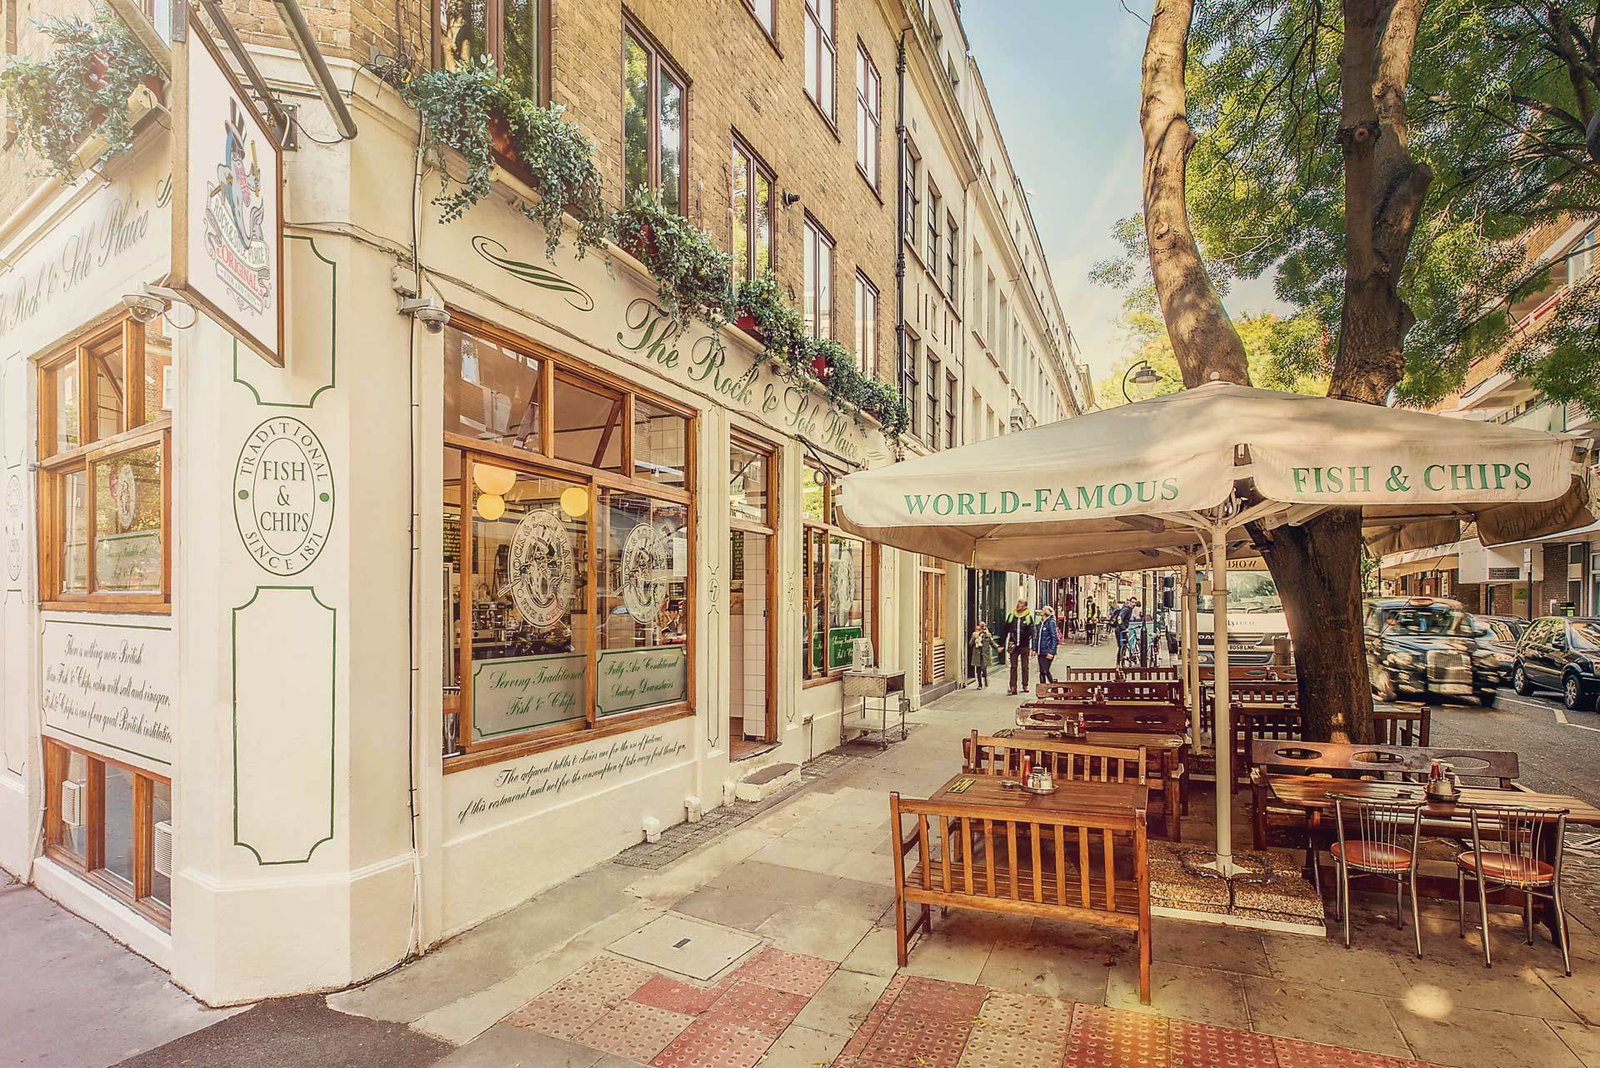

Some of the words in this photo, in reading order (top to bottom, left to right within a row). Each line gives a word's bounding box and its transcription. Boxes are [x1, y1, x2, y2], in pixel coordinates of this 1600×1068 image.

[9, 262, 45, 330] Rock
[62, 221, 95, 292] Sole
[98, 193, 149, 267] Plaice
[222, 245, 258, 292] ORIGINAL
[617, 298, 679, 369] The
[687, 335, 759, 404] Rock
[761, 383, 779, 414] &
[784, 386, 819, 438] Sole
[821, 410, 858, 458] Plaice
[240, 422, 328, 482] TRADITIONAL
[262, 460, 305, 481] FISH
[1291, 465, 1371, 493] FISH
[1385, 465, 1411, 492] &
[1423, 462, 1532, 491] CHIPS
[276, 485, 290, 506] &
[904, 477, 1179, 516] WORLD-FAMOUS
[260, 511, 309, 532] CHIPS
[245, 531, 294, 570] SINCE
[299, 532, 323, 562] 1871
[119, 639, 145, 665] British
[489, 670, 531, 692] Serving
[532, 665, 588, 684] Traditional
[604, 660, 625, 679] Fully
[626, 659, 641, 673] Air
[505, 696, 533, 716] Fish
[535, 698, 544, 711] &
[548, 691, 576, 713] Chips
[119, 706, 145, 735] British
[495, 766, 519, 788] The
[458, 800, 474, 824] of
[471, 797, 486, 815] this
[488, 785, 531, 810] restaurant
[530, 779, 549, 797] and
